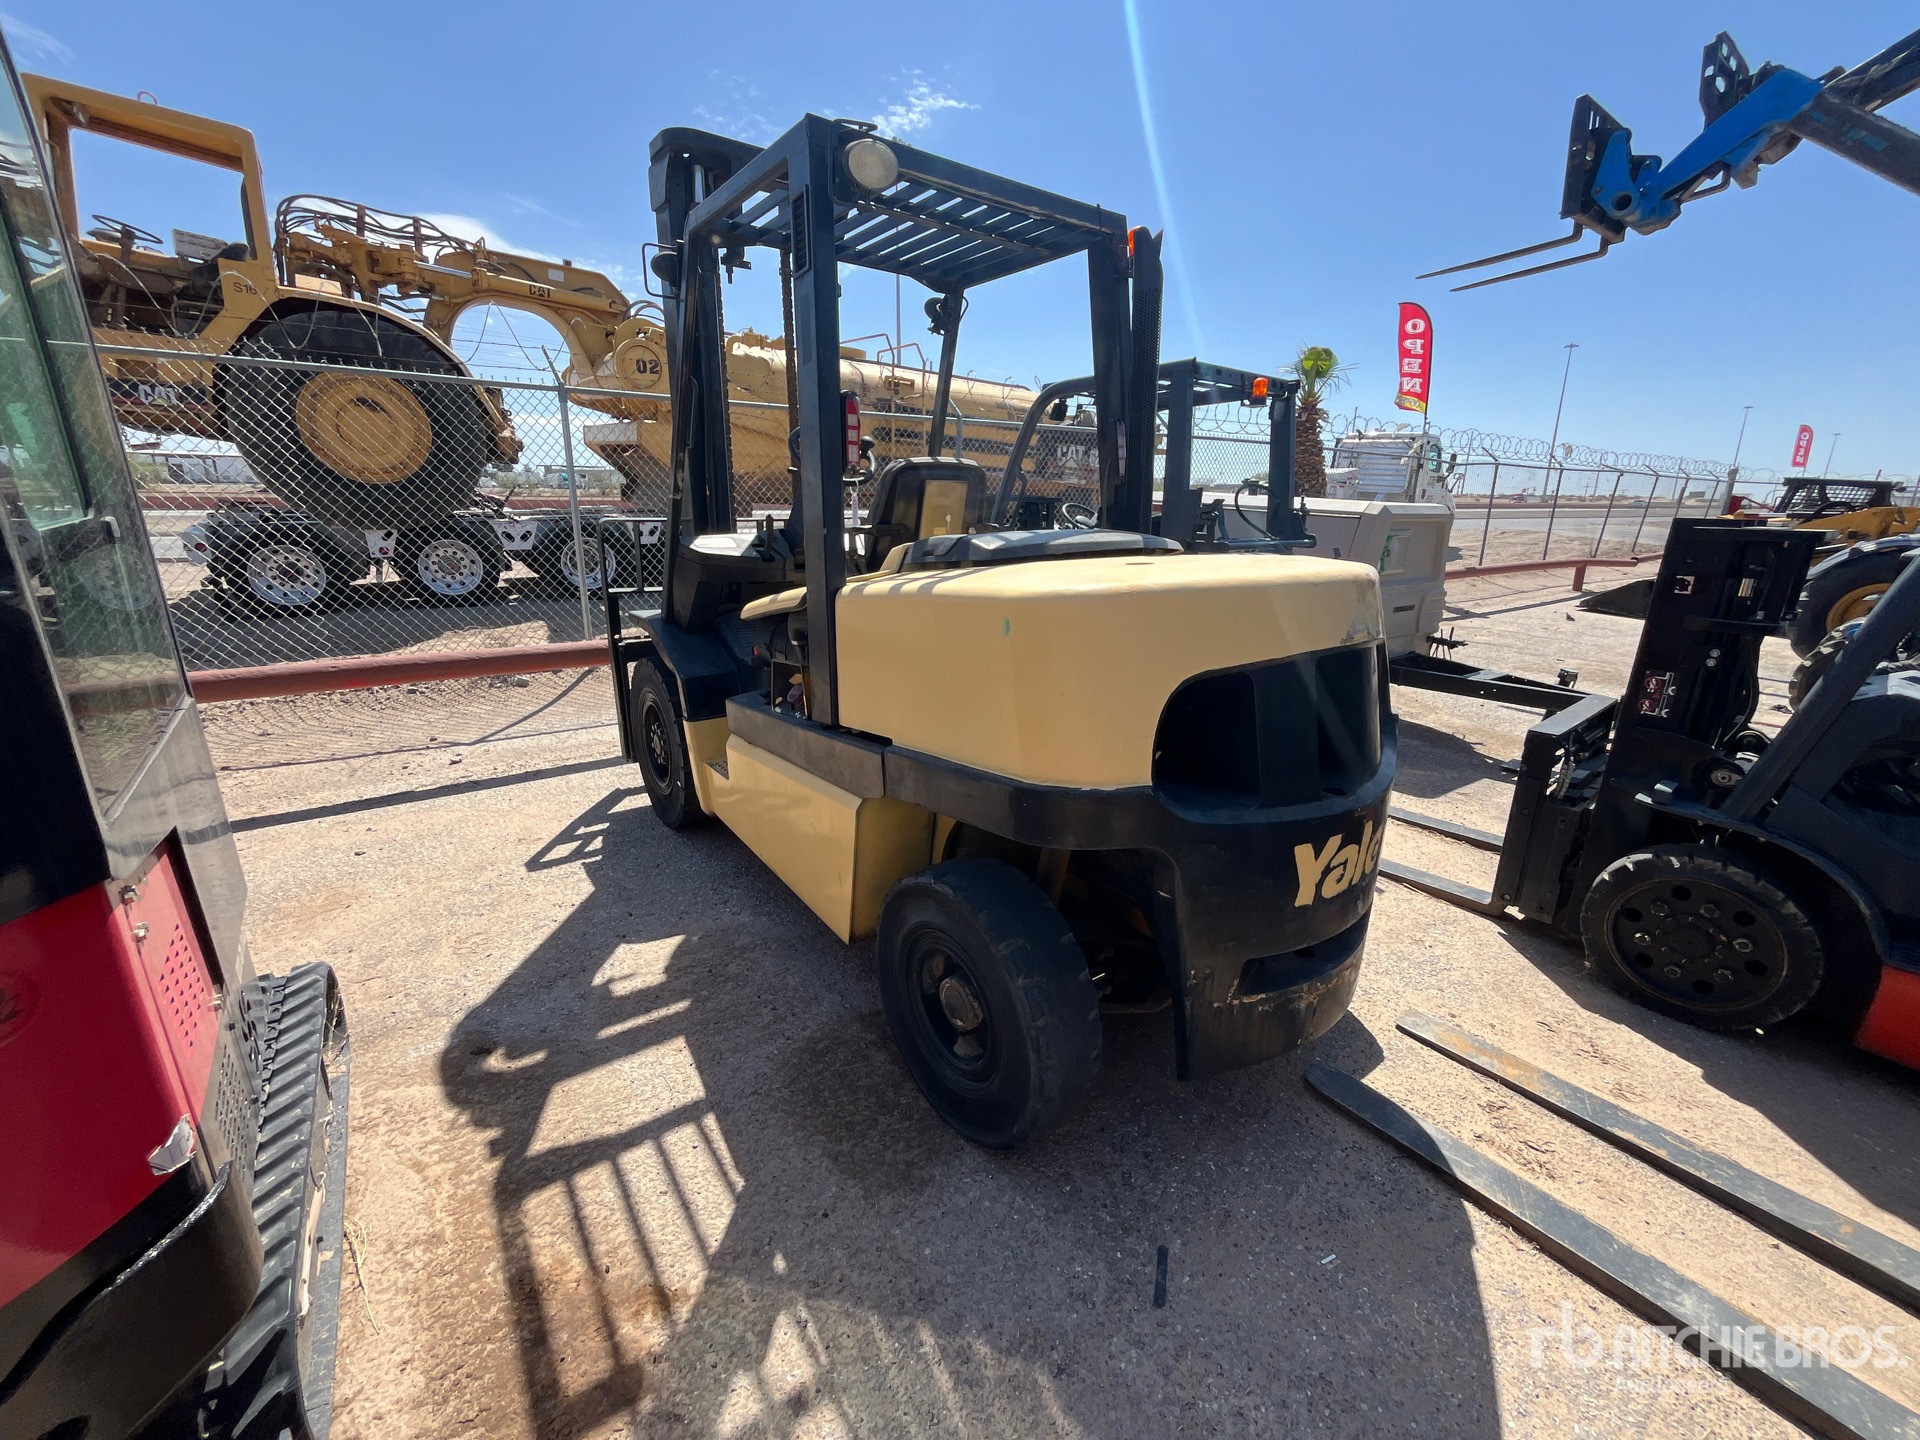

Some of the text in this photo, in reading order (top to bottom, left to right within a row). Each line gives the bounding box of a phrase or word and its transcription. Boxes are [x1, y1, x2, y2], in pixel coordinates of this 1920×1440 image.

[233, 281, 257, 295] S16
[529, 284, 551, 299] CAT
[636, 358, 660, 375] 02
